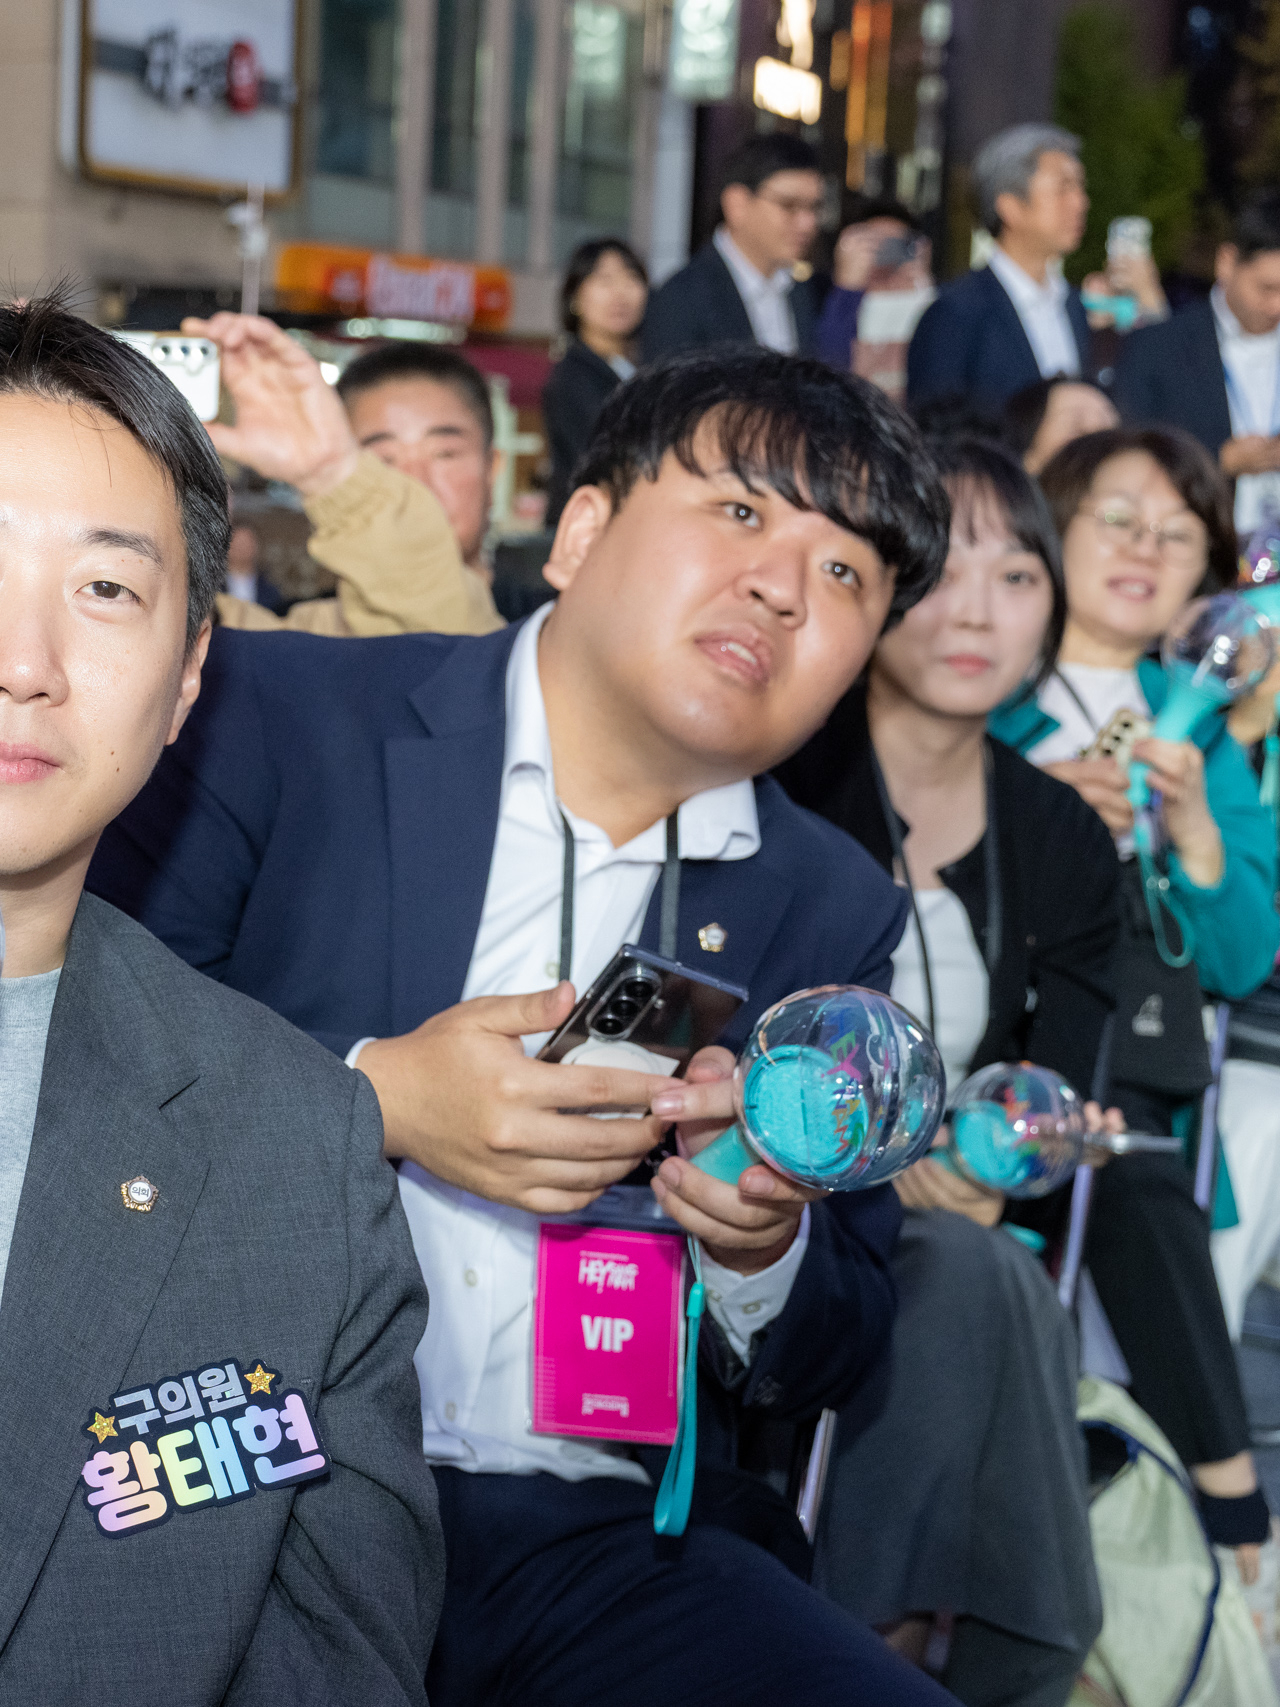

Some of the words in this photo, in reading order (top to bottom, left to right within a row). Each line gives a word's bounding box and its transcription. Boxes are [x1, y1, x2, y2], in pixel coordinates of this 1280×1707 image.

[580, 1314, 634, 1353] VIP
[113, 1364, 248, 1435] 구의원
[81, 1394, 326, 1532] 황태현
